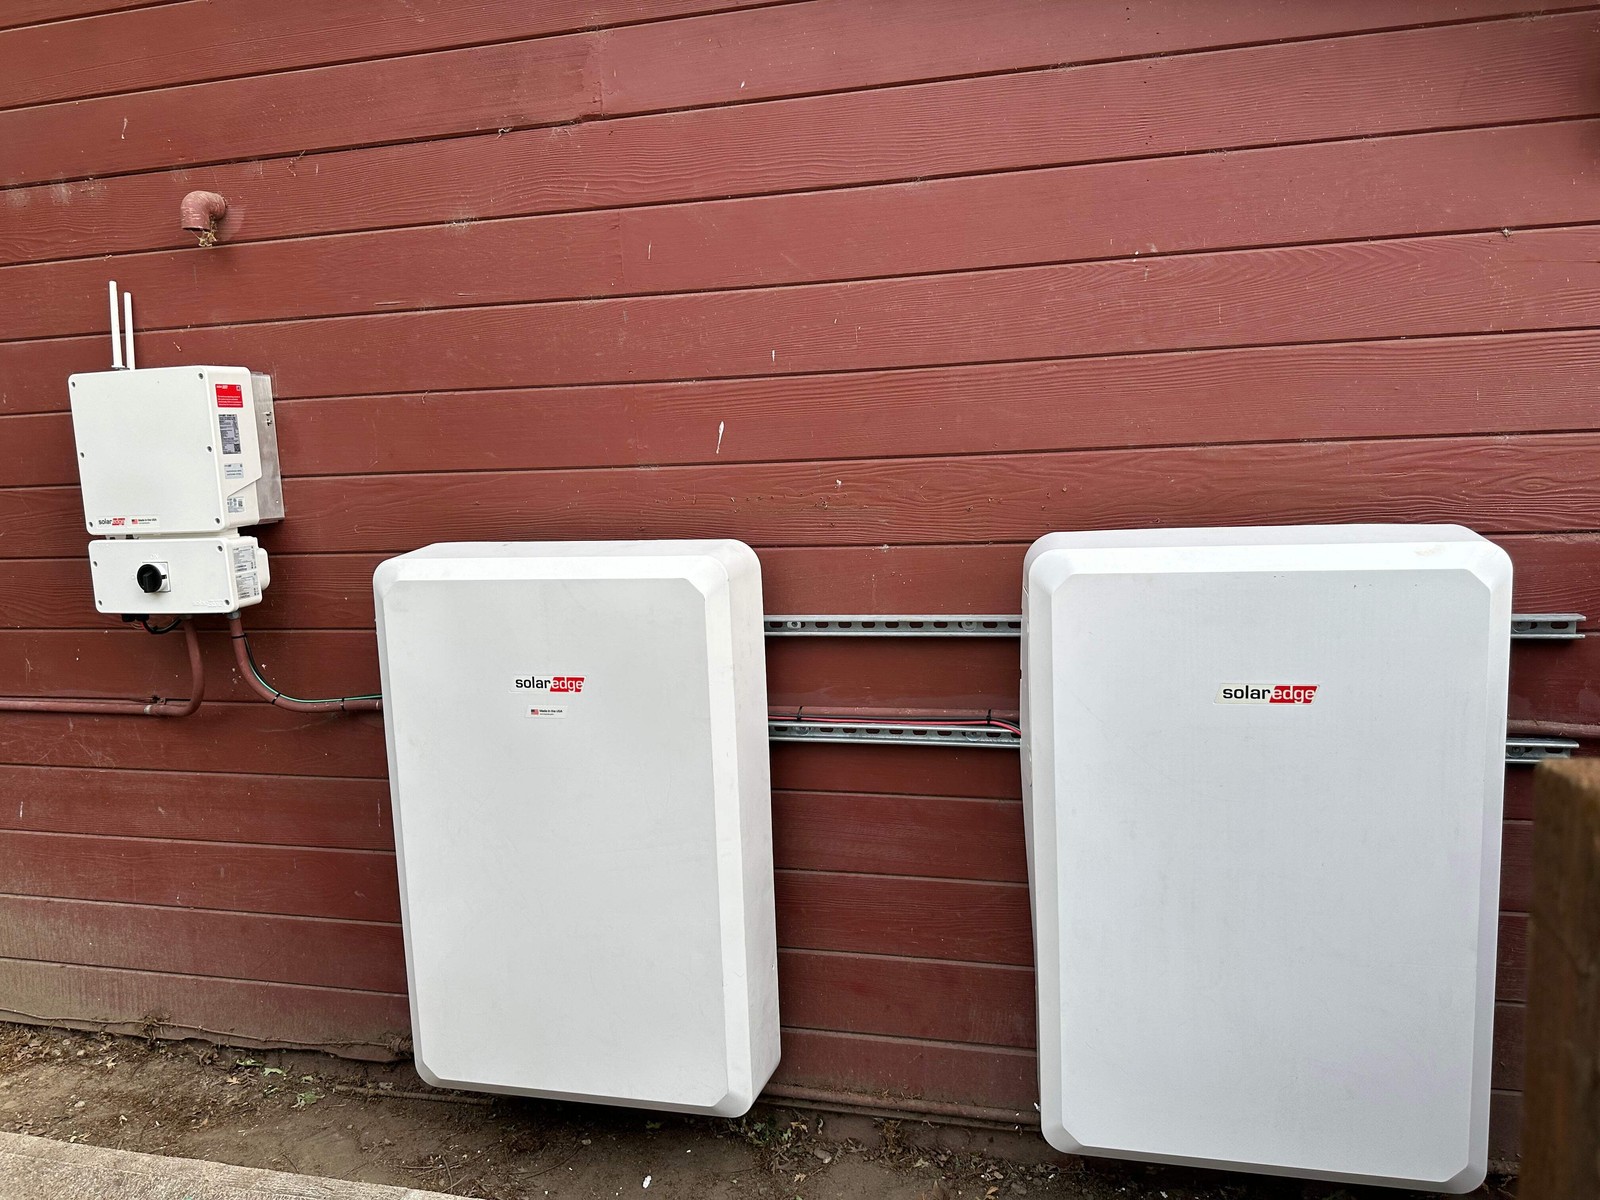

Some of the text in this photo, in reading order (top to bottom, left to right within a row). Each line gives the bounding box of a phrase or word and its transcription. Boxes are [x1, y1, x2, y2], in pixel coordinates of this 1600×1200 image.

[98, 517, 125, 526] solaredge
[515, 676, 583, 692] solaredge
[1222, 685, 1315, 703] solaredge
